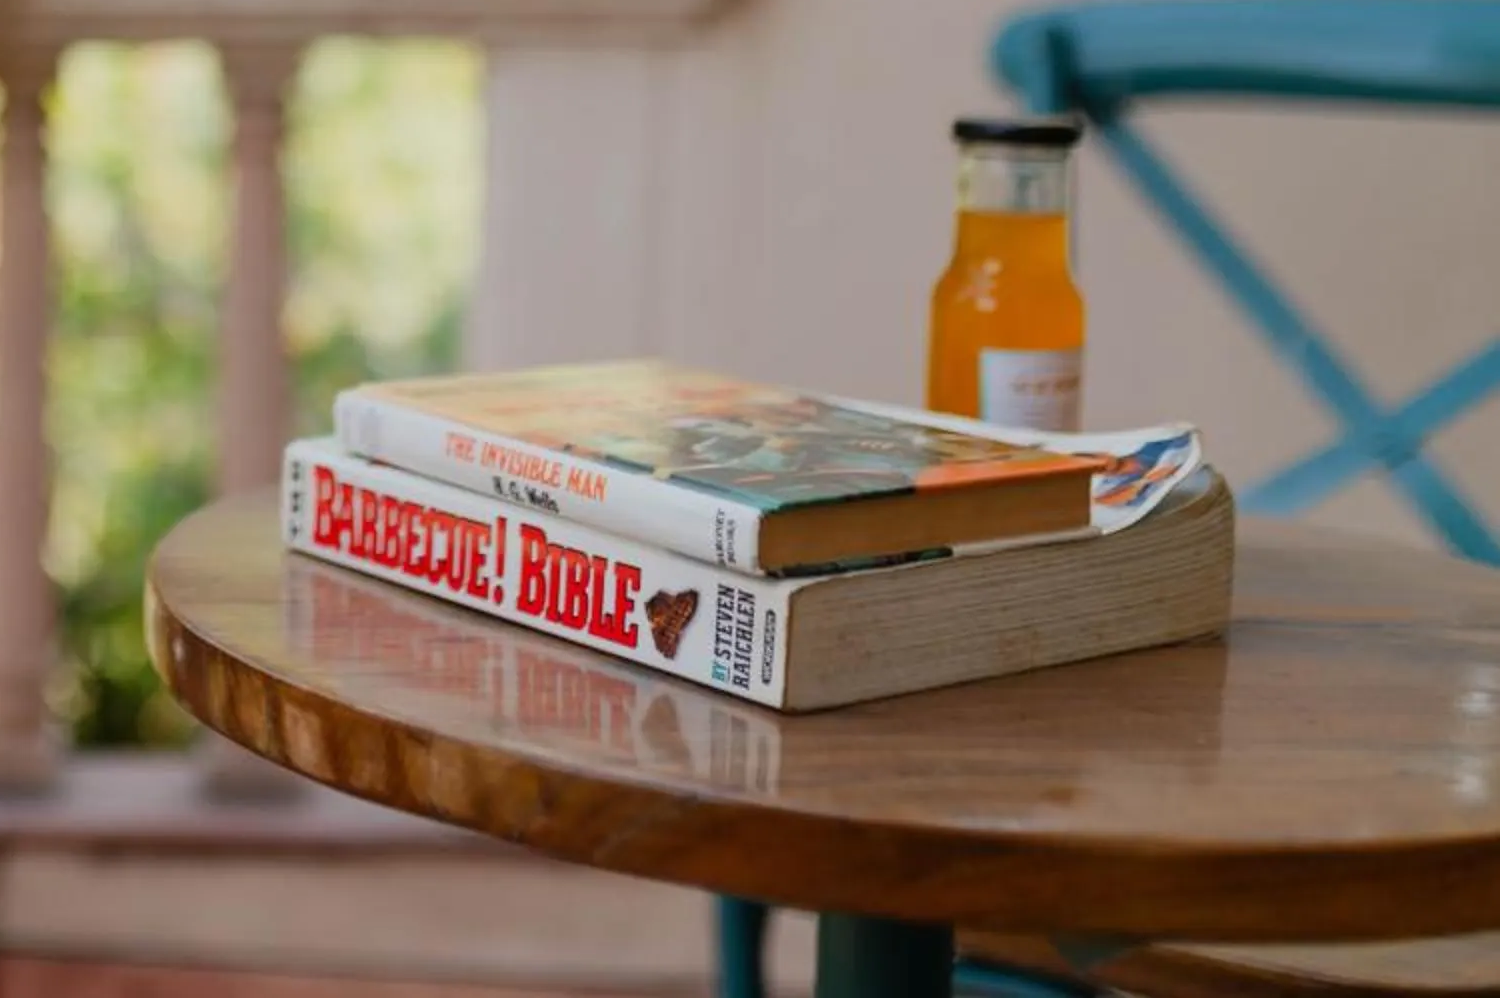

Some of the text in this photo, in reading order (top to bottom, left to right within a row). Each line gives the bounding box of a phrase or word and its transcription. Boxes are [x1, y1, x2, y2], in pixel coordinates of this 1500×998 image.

[446, 432, 607, 502] THE INVISIBLE MAN
[313, 464, 507, 606] BARBECUE!
[516, 523, 642, 649] BIBLE
[714, 583, 736, 661] STEVEN
[732, 589, 756, 690] RAICHLEN
[711, 659, 731, 684] BY
